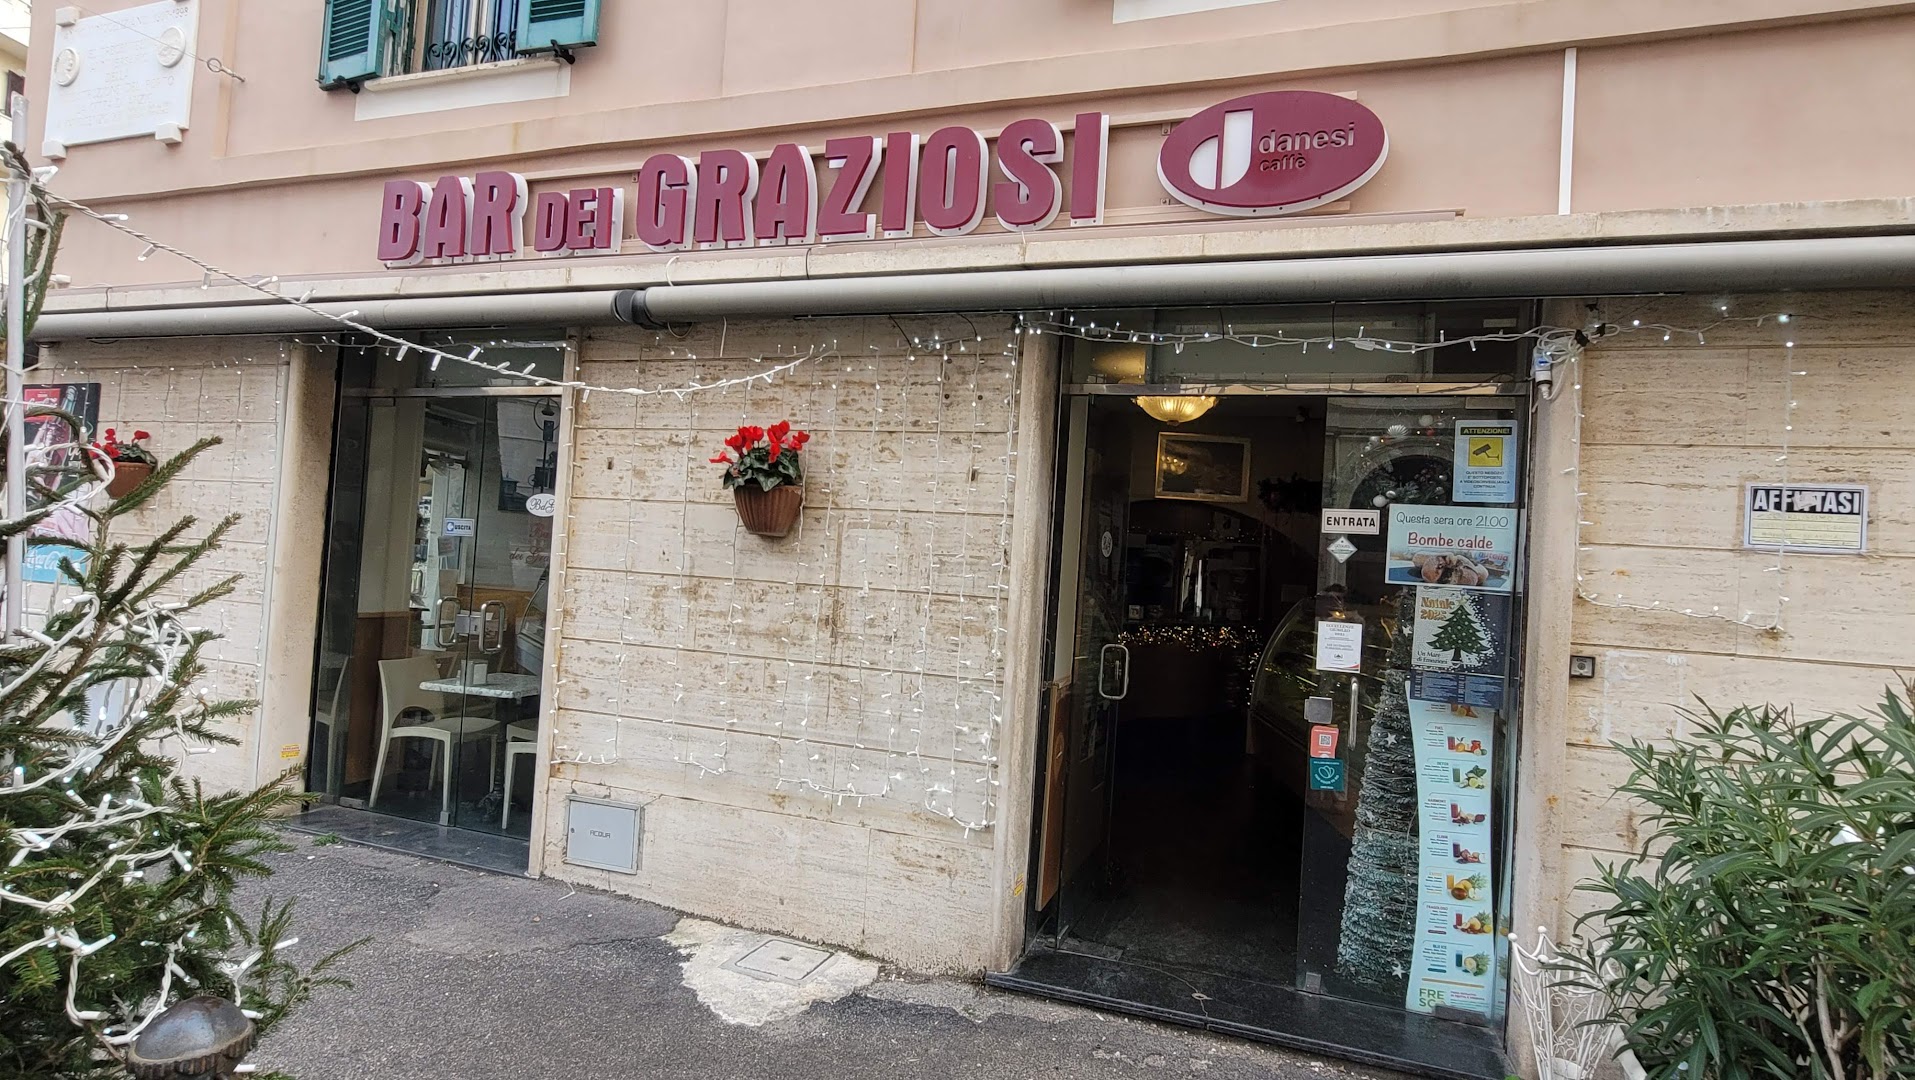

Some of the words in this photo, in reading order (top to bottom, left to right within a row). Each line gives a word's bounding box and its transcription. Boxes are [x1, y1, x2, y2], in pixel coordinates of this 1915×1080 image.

[1258, 121, 1356, 154] danesi
[1259, 153, 1307, 172] caffè
[377, 170, 521, 263] BAR
[534, 187, 616, 252] DEI
[636, 112, 1101, 246] GRAZIOSI
[1326, 516, 1376, 528] ENTRATA
[1396, 511, 1430, 525] Questa
[1433, 517, 1454, 526] sera
[1457, 518, 1473, 526] ore
[1476, 515, 1508, 528] 21.00
[1408, 531, 1454, 547] Bombe
[1457, 535, 1493, 549] calde
[1421, 596, 1455, 609] Natale
[589, 829, 611, 839] ACQUA
[1419, 988, 1445, 1000] FRE
